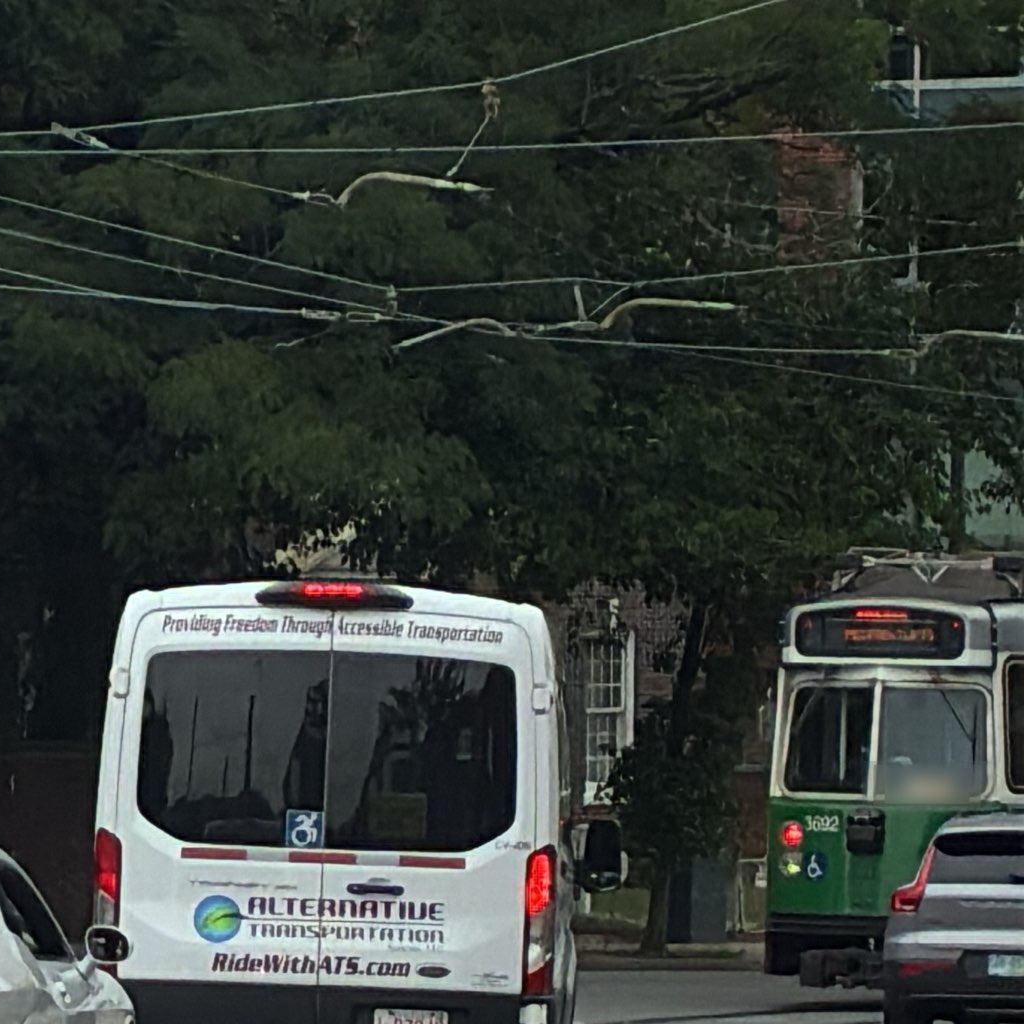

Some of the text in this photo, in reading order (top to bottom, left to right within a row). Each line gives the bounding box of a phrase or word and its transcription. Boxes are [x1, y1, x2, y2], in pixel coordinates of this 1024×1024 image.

[162, 614, 504, 644] Providing Freedom Through Accessible Transportation
[805, 815, 840, 831] 3692
[248, 896, 445, 921] ALTERNATIVE
[248, 923, 444, 944] TRANSPORTATION
[211, 952, 411, 977] RideWithATS.com
